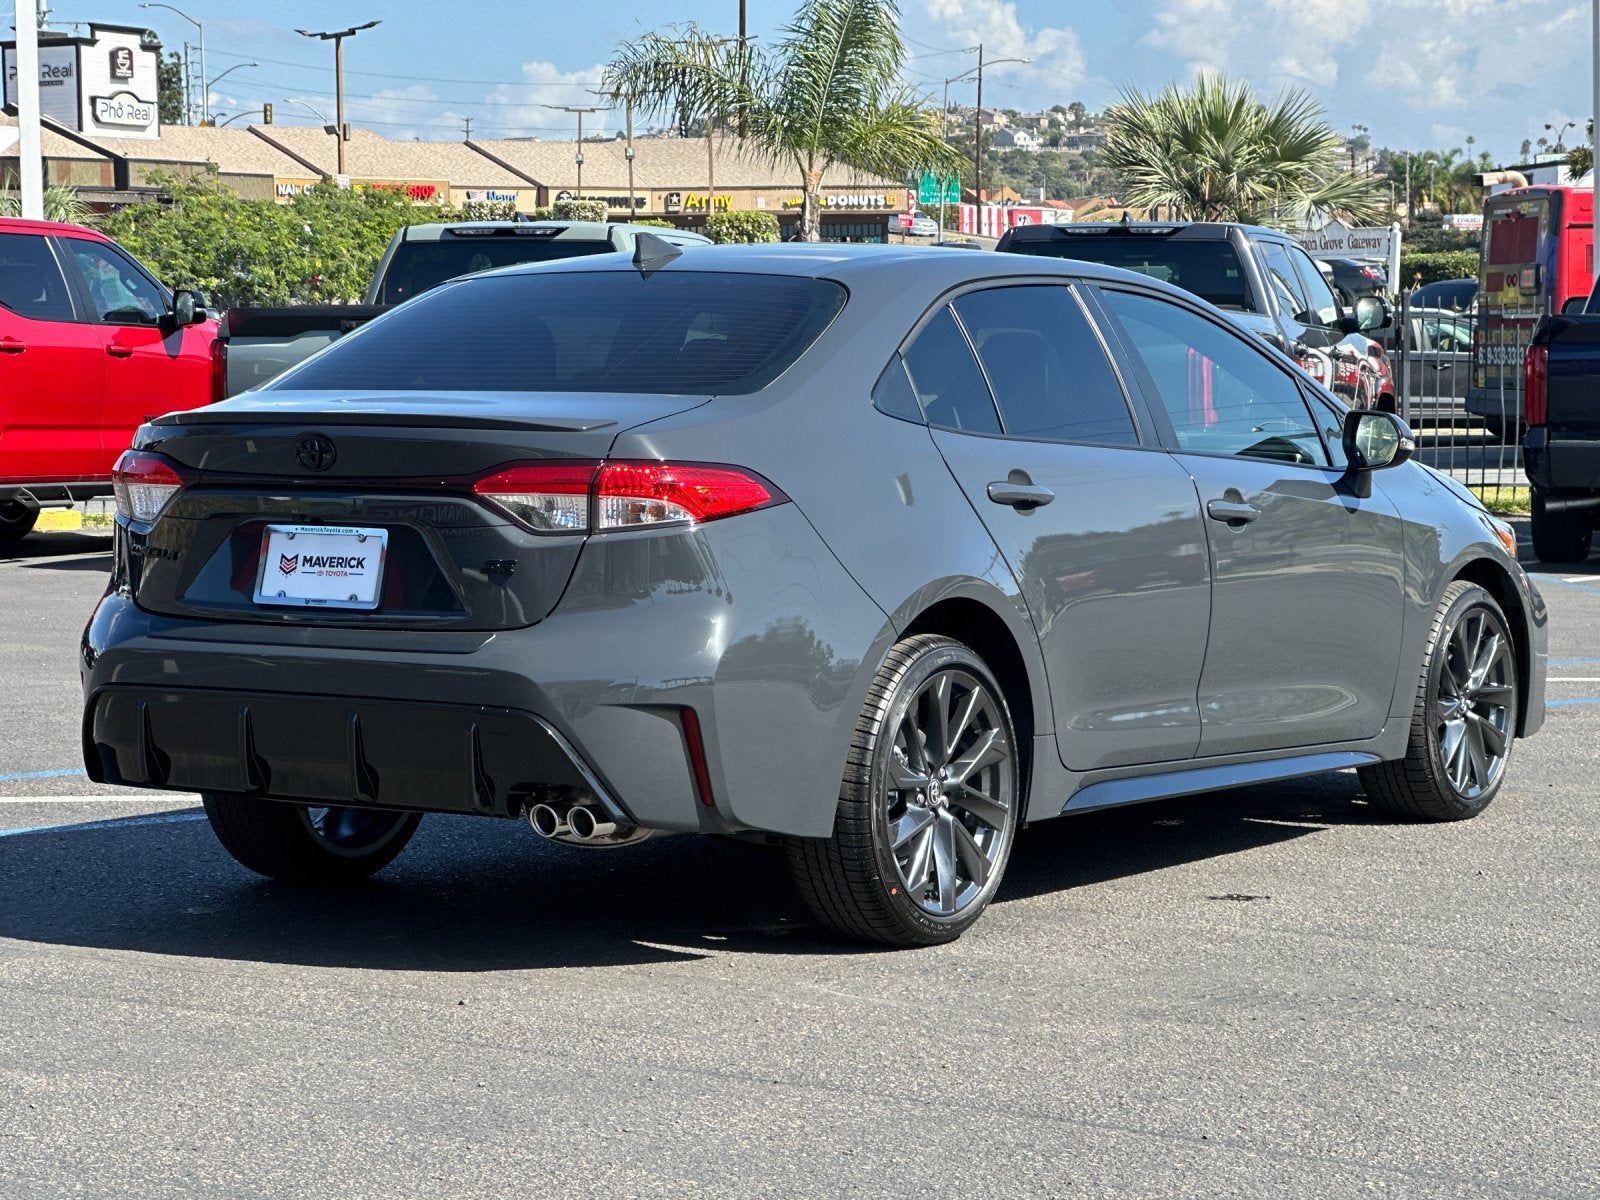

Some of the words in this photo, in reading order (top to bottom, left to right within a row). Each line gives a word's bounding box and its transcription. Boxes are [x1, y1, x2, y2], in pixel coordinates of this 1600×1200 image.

[42, 63, 72, 78] Real
[126, 104, 151, 121] Real
[408, 184, 436, 198] SHOP
[686, 192, 734, 209] Army
[827, 194, 886, 206] DONUTS
[1319, 234, 1344, 250] Grove
[1347, 233, 1382, 252] Gateway
[300, 526, 354, 535] MaverickToyota.com
[302, 555, 366, 569] MAVERICK
